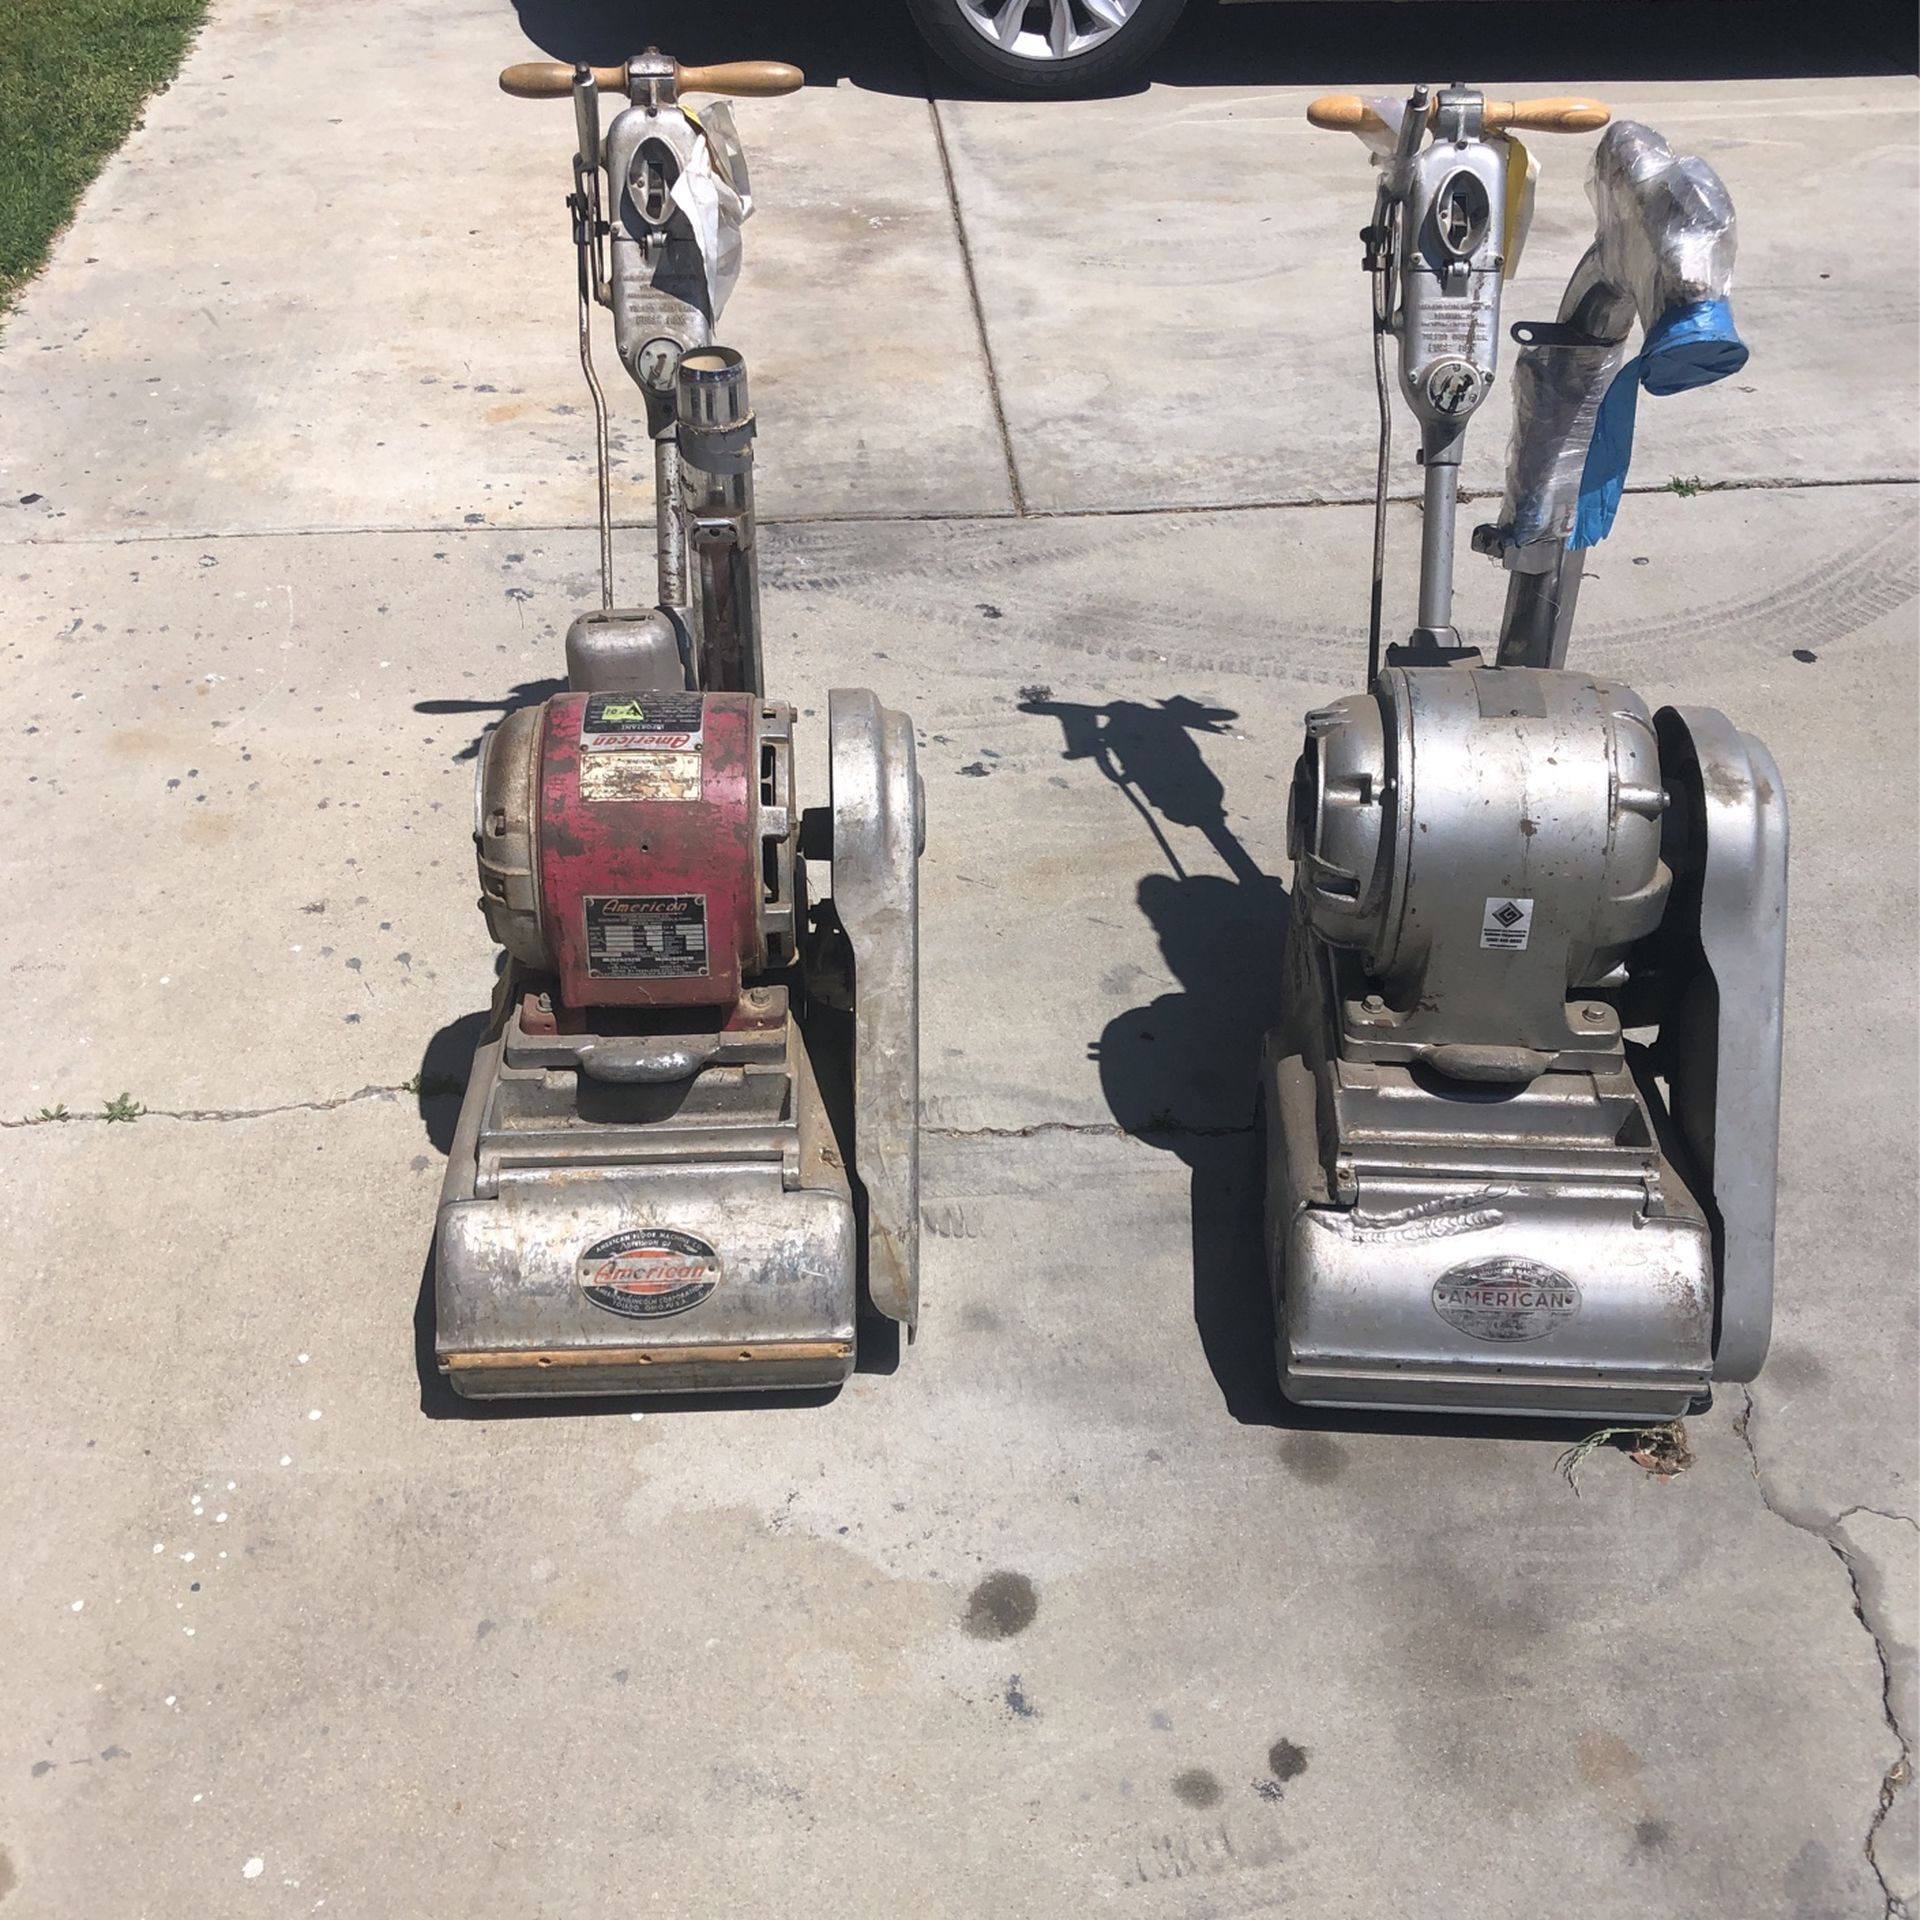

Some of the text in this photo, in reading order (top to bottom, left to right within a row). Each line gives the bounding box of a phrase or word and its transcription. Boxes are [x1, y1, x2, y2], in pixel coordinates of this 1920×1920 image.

[592, 734, 691, 749] American
[602, 899, 688, 915] American
[596, 1234, 631, 1253] AMERICAN
[632, 1231, 656, 1241] FLOOR
[593, 1259, 706, 1285] American
[1448, 1290, 1564, 1308] AMERICAN
